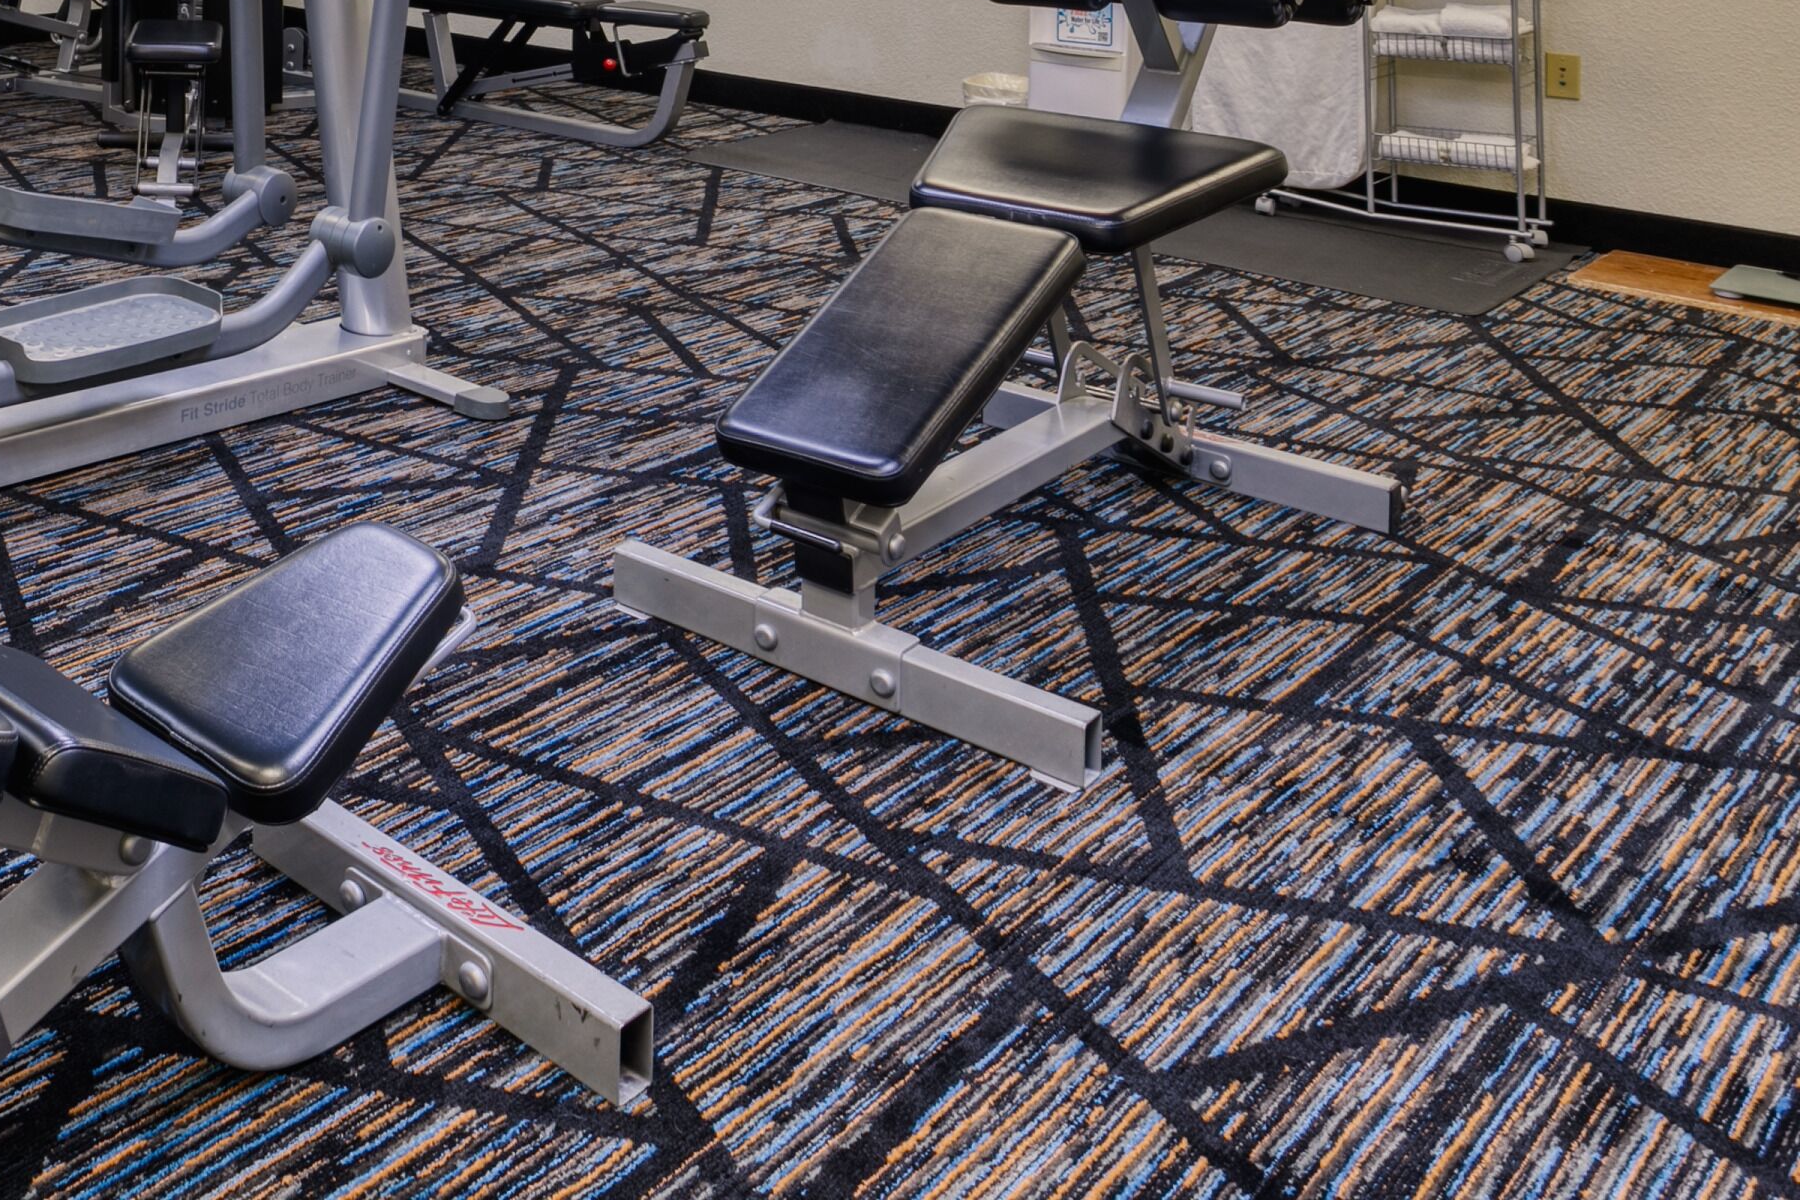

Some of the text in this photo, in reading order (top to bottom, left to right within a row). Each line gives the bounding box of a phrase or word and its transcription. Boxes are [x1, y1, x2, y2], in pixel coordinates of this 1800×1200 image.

[181, 368, 357, 423] Fit Stride Total Body Trainer
